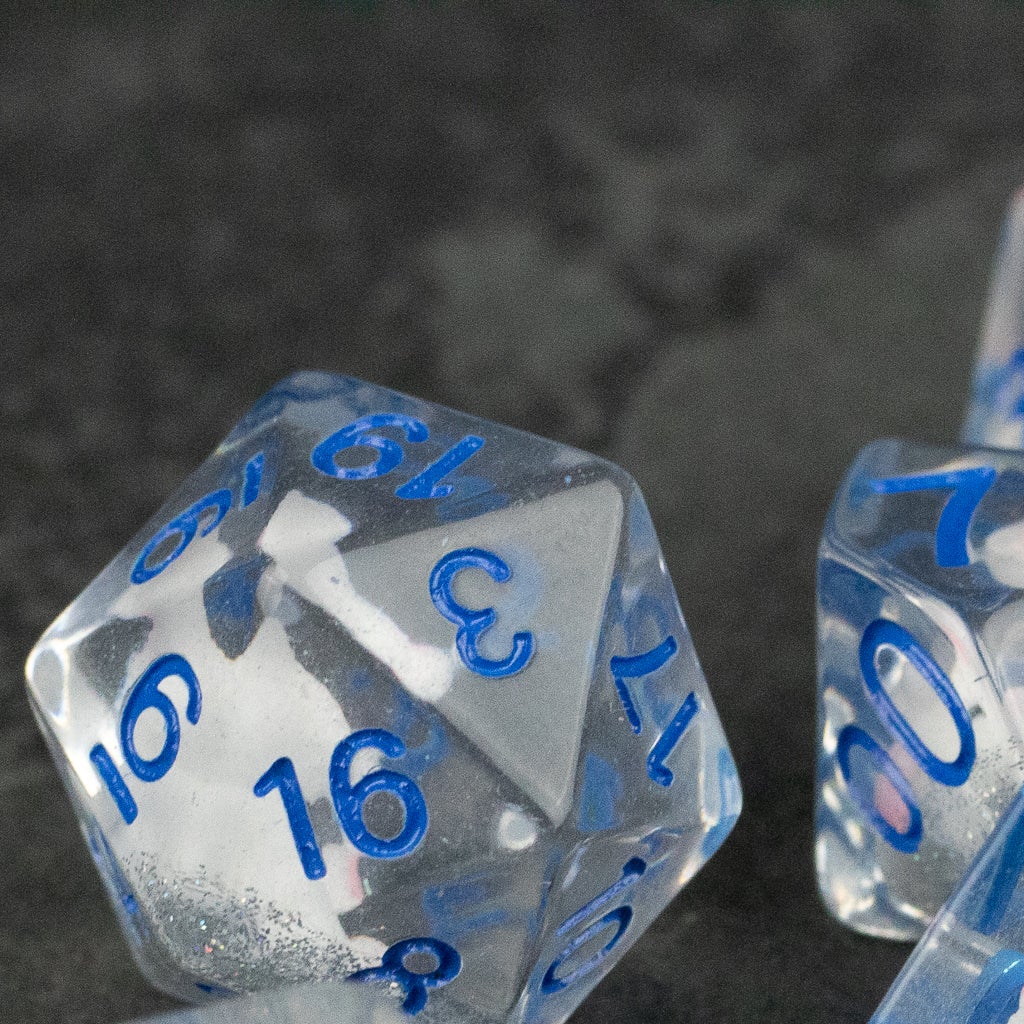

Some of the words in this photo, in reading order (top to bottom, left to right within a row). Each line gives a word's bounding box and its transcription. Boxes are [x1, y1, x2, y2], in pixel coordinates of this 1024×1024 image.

[310, 412, 486, 501] 19
[427, 547, 534, 678] 3
[608, 634, 699, 788] 17
[836, 618, 977, 855] 00
[252, 727, 430, 881] 16
